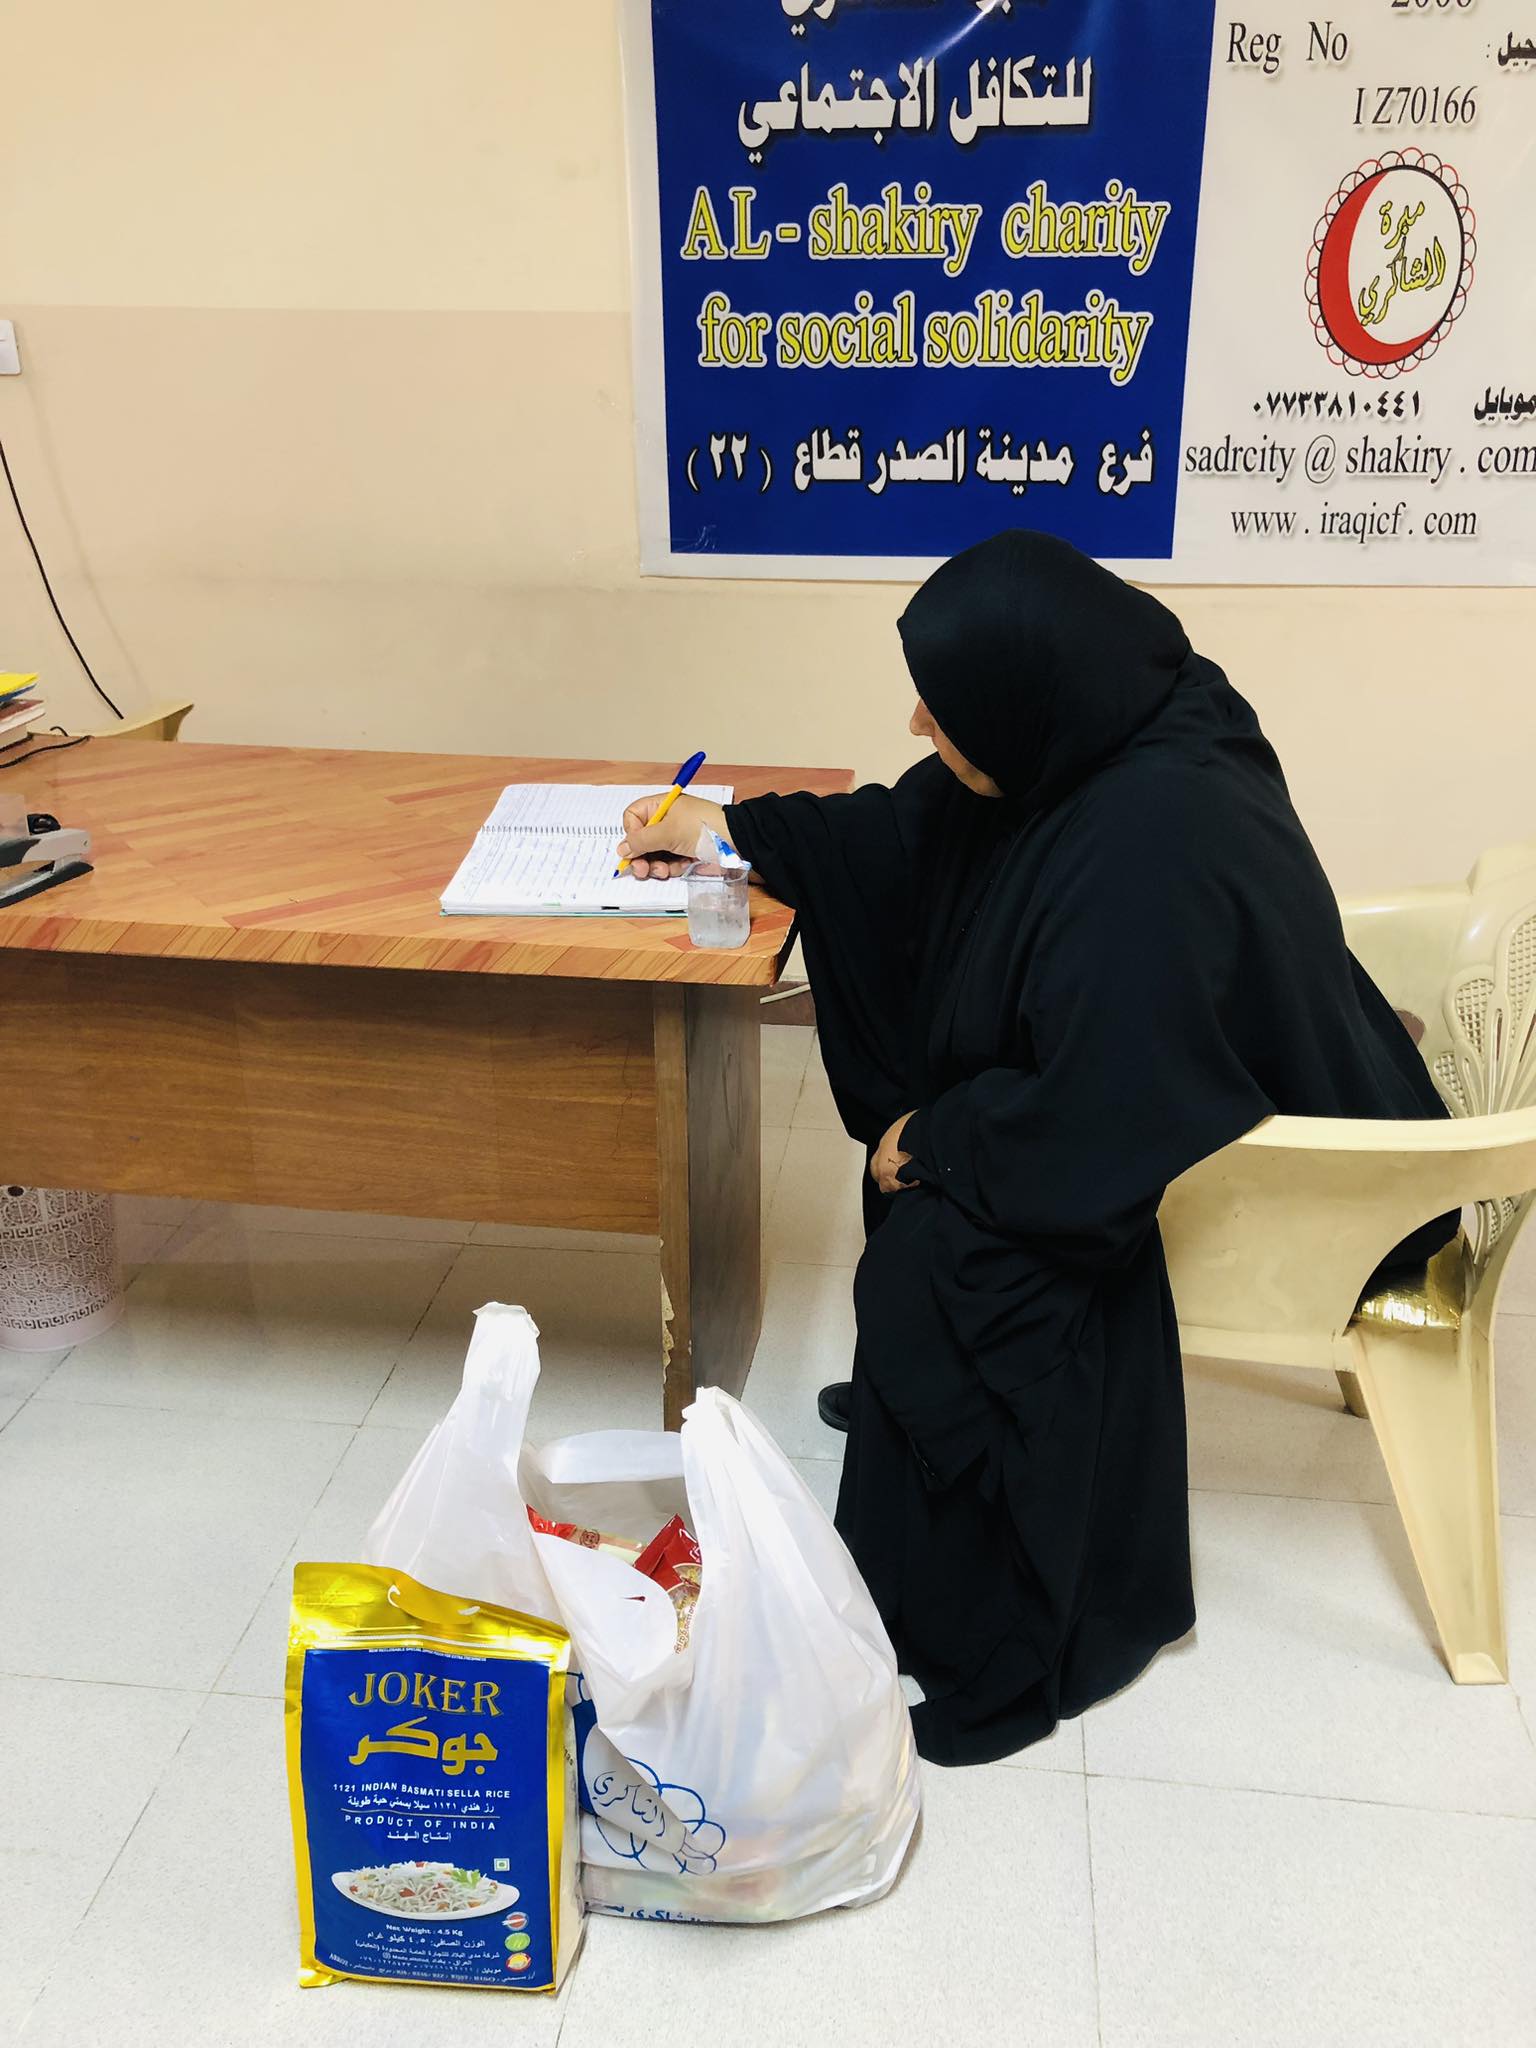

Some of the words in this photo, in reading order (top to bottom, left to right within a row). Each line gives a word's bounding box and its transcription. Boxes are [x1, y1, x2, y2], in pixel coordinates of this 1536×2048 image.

[1226, 22, 1282, 74] Reg
[1306, 21, 1348, 62] No
[737, 57, 937, 164] الاجتماعي
[950, 55, 1093, 146] للتكافل
[808, 181, 983, 276] shakiry
[1001, 179, 1172, 276] charity
[698, 291, 771, 369] for
[777, 290, 918, 369] social
[922, 289, 1154, 386] solidarity
[794, 429, 862, 492] قطاع
[868, 429, 966, 495] الصدر
[976, 428, 1075, 495] مدينة
[1097, 430, 1154, 494] فرع
[348, 1671, 503, 1717] JOKER
[348, 1716, 499, 1776] جوكر
[333, 1783, 356, 1793] 1121
[361, 1782, 398, 1792] INDIAN
[401, 1784, 445, 1797] BASMATI
[447, 1789, 480, 1798] SELLA
[485, 1790, 511, 1799] RICE
[347, 1795, 371, 1808] طويلة
[483, 1803, 495, 1813] رز
[344, 1814, 413, 1828] PRODUCT
[424, 1819, 442, 1829] OF
[452, 1821, 496, 1831] INDIA
[402, 1926, 431, 1935] Weight
